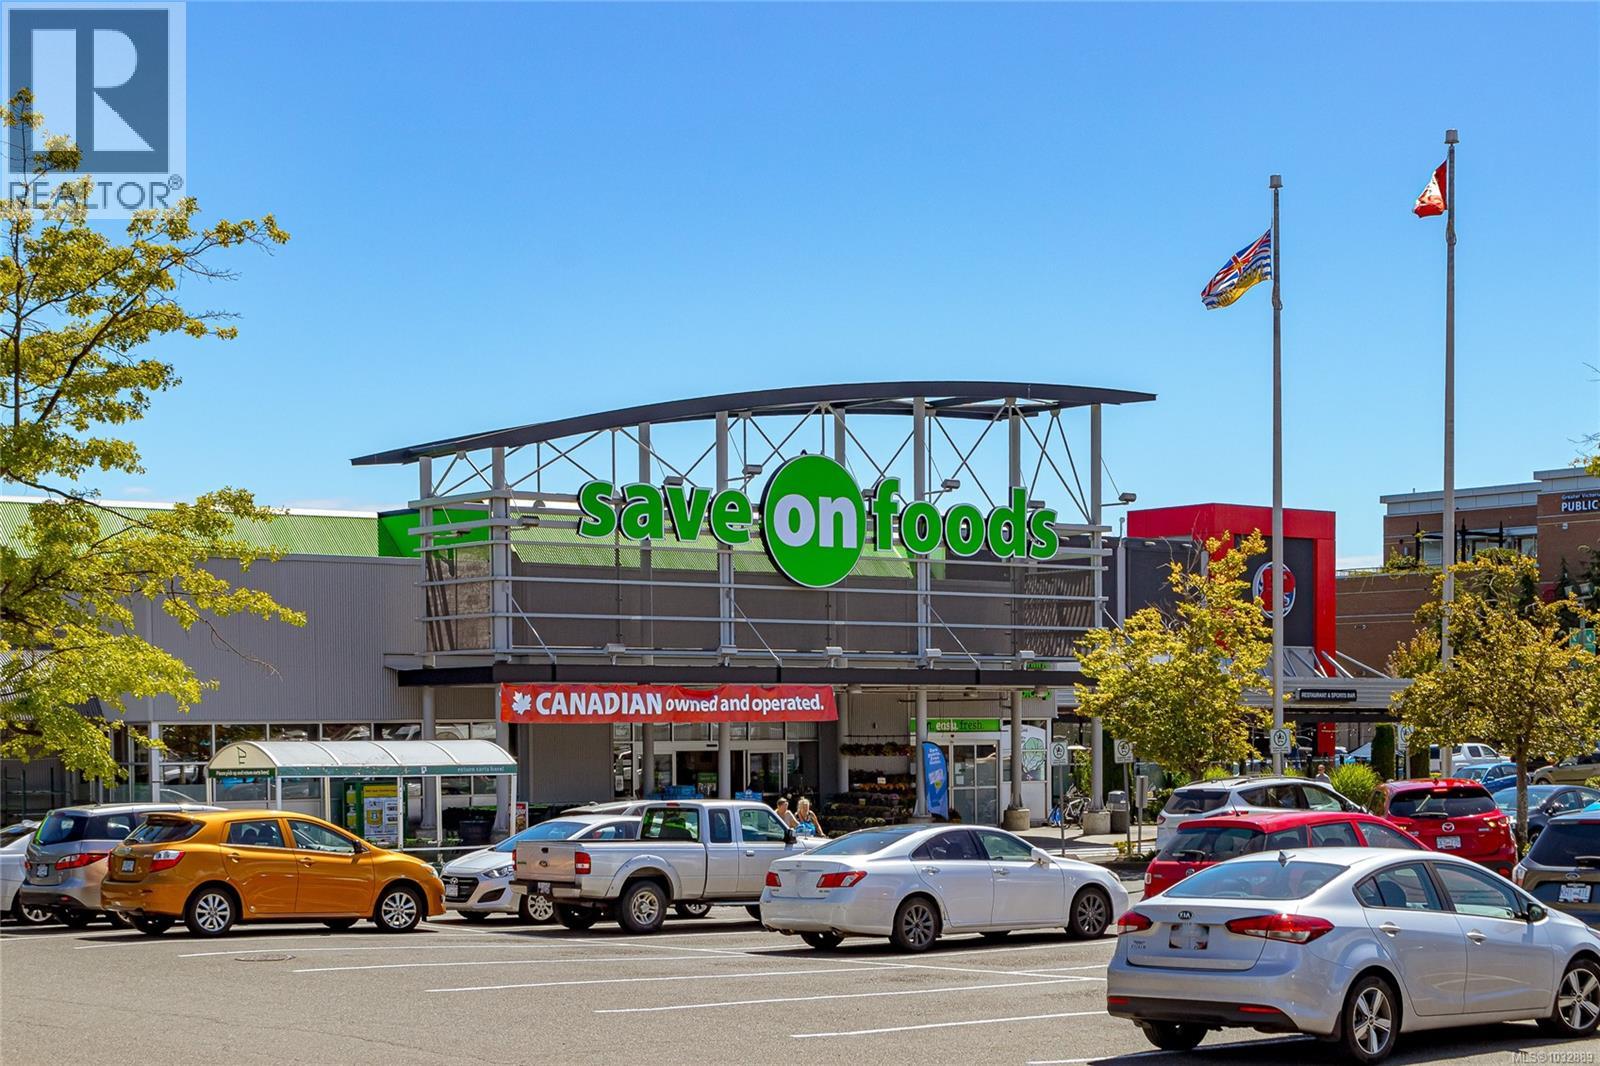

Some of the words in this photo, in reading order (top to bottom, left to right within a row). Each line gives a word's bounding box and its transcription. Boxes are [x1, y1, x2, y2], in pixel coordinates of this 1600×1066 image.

[1561, 500, 1598, 511] PUBLIC
[578, 479, 753, 546] save
[773, 493, 857, 549] on
[870, 476, 1060, 561] foods
[1301, 691, 1327, 699] RESTAURANT
[1331, 691, 1346, 699] SPORTS
[1347, 691, 1356, 699] BAR
[535, 691, 662, 716] CANADIAN
[665, 694, 718, 712] owned
[720, 694, 749, 711] and
[752, 693, 825, 715] operated.
[935, 718, 959, 732] easy.
[960, 719, 985, 730] fresh.
